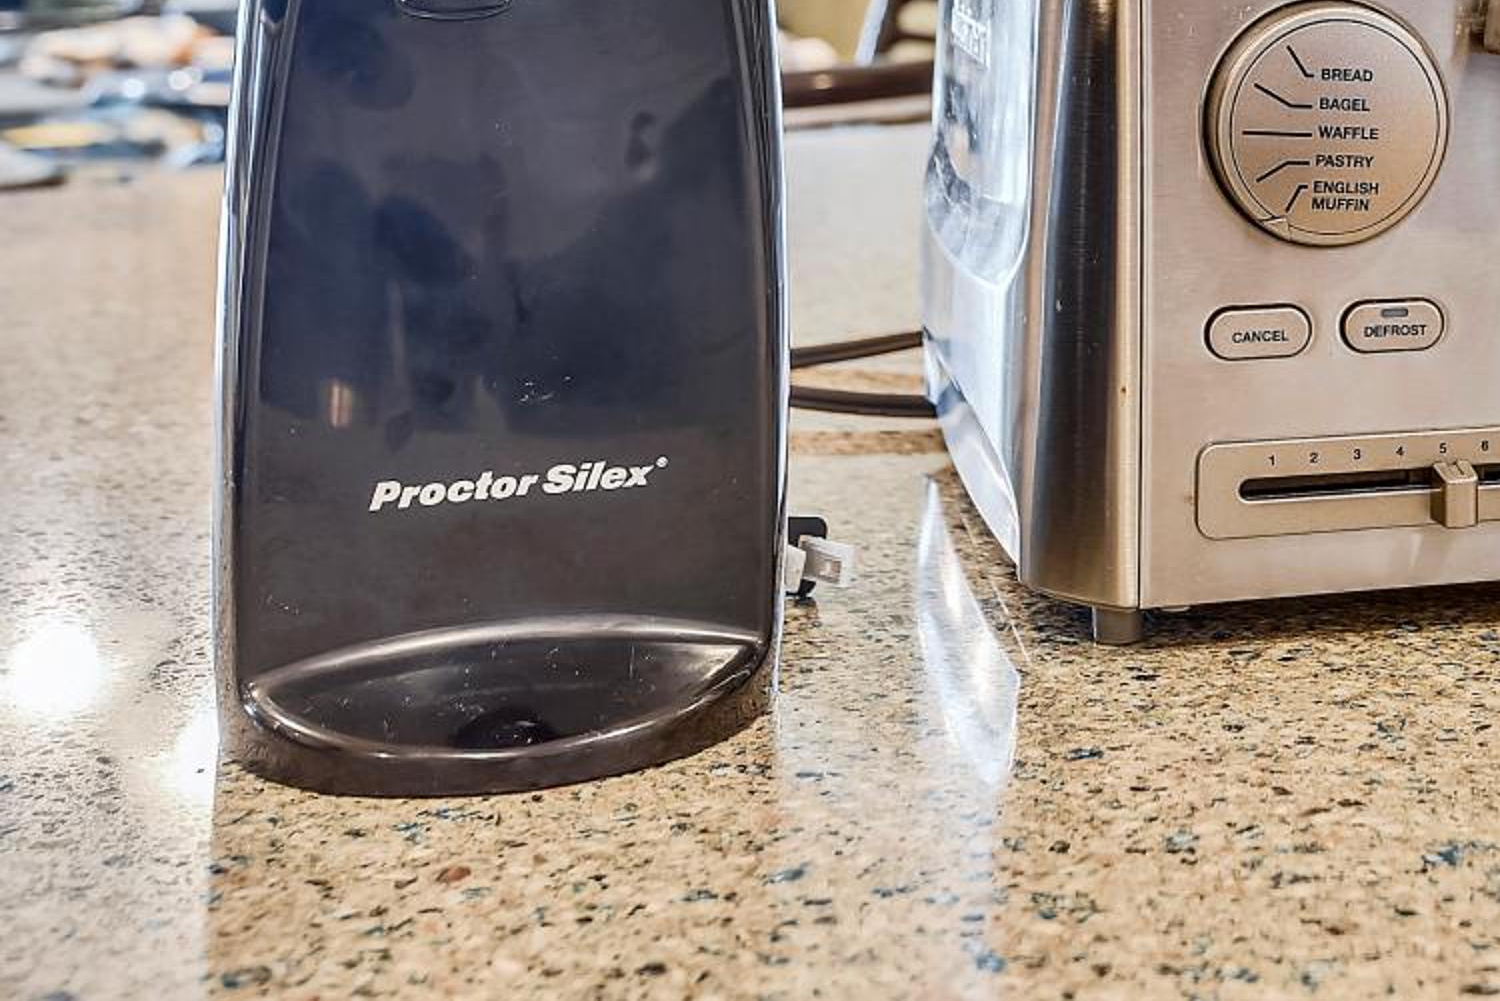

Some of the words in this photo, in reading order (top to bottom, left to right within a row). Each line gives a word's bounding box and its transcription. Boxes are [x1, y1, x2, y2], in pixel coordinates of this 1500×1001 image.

[1321, 68, 1373, 82] BREAD
[1319, 97, 1370, 112] BAGEL
[1318, 126, 1379, 140] WAFFLE
[1315, 155, 1374, 168] PASTRY
[1313, 181, 1379, 194] ENGLISH
[1311, 198, 1369, 211] MUFFIN
[1231, 330, 1289, 344] CANCEL
[1364, 324, 1427, 338] DEFROST
[1269, 455, 1275, 465] 1
[1310, 452, 1318, 464] 2
[1353, 449, 1361, 460] 3
[1396, 445, 1404, 457] 4
[1438, 443, 1446, 454] 5
[1481, 440, 1489, 451] 6
[369, 471, 539, 511] Proctor
